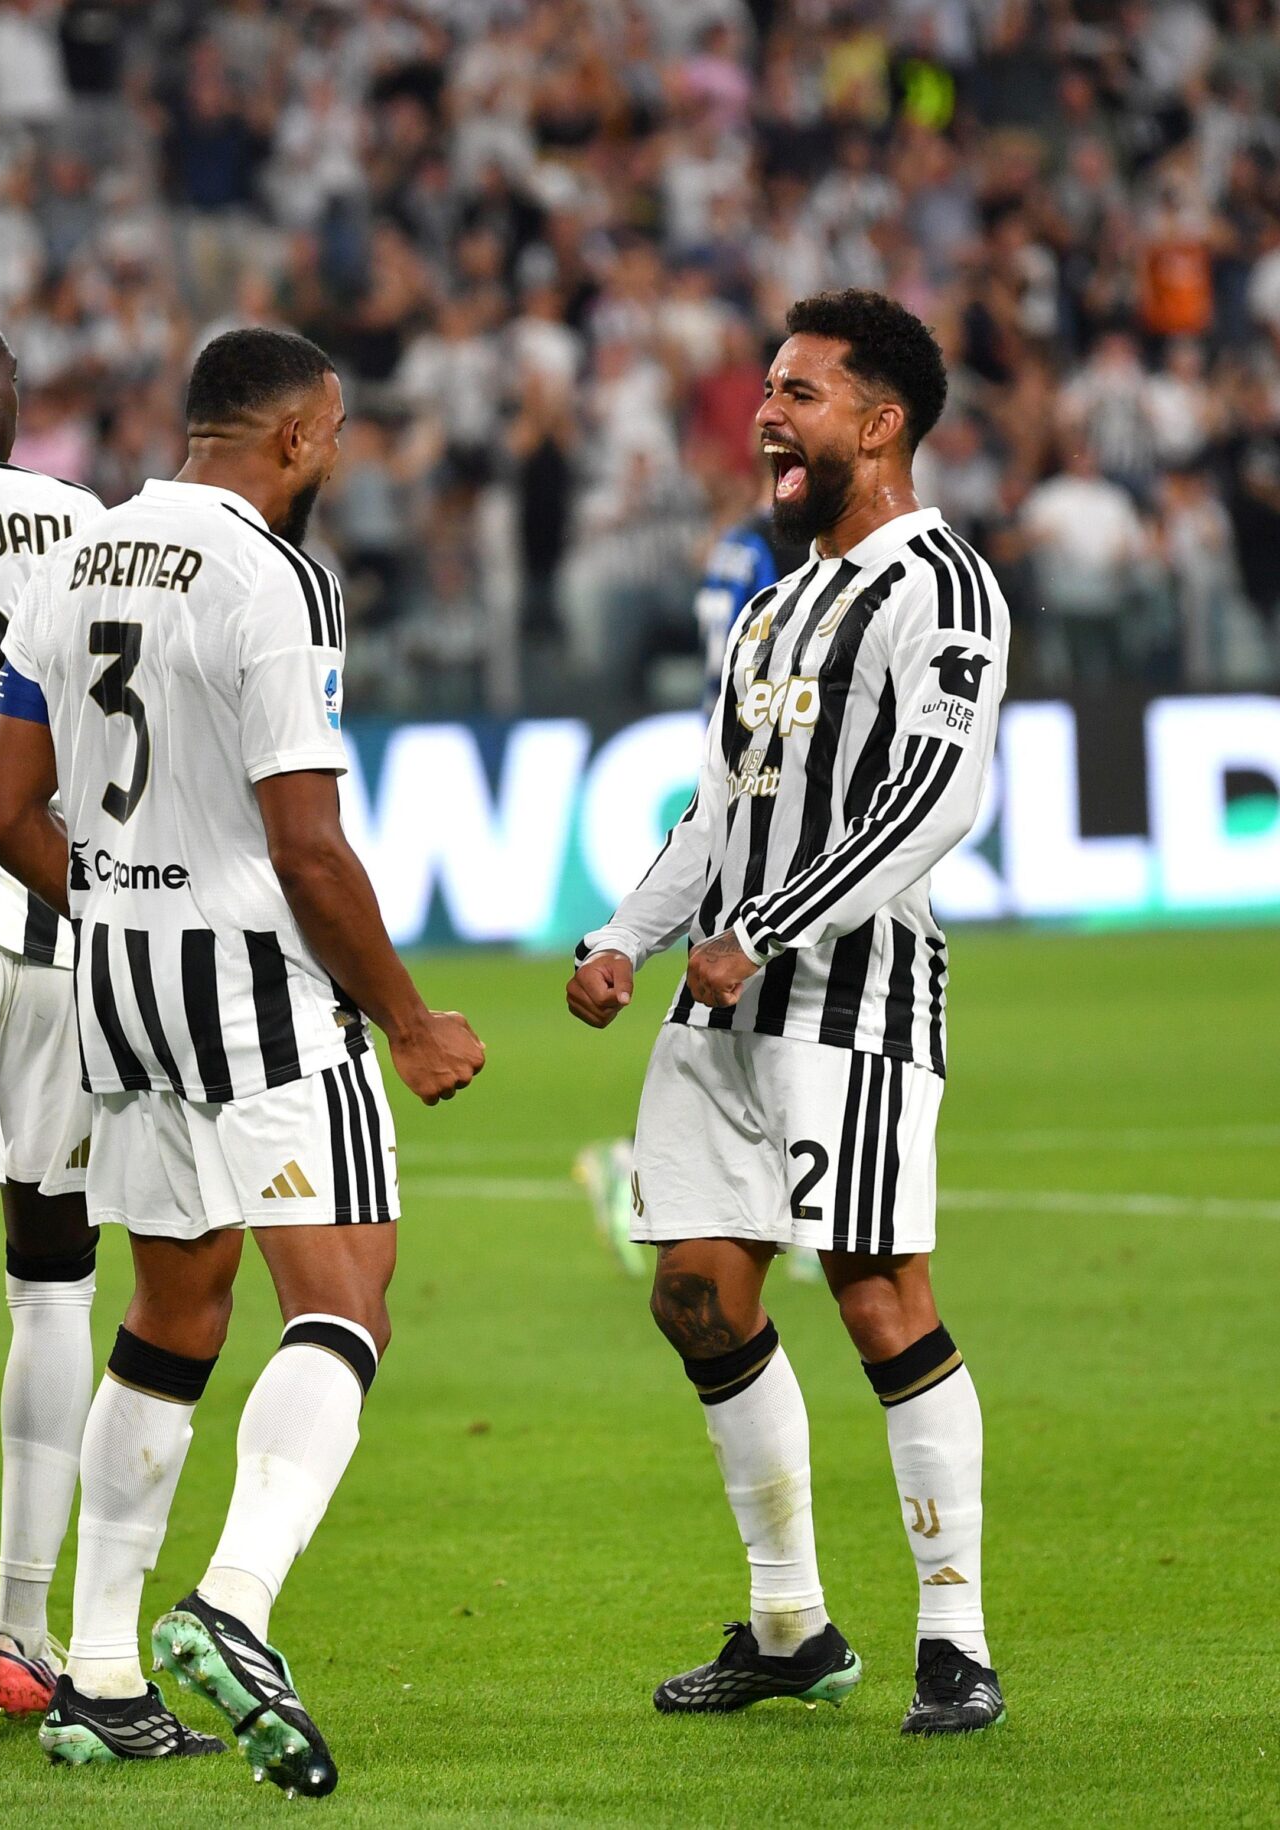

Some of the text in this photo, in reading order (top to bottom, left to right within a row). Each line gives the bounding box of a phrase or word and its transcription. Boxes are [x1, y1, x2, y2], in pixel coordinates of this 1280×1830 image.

[70, 540, 203, 593] BREMER
[89, 621, 150, 826] 3
[922, 699, 974, 720] white
[945, 716, 972, 734] bit
[784, 1138, 829, 1221] 2
